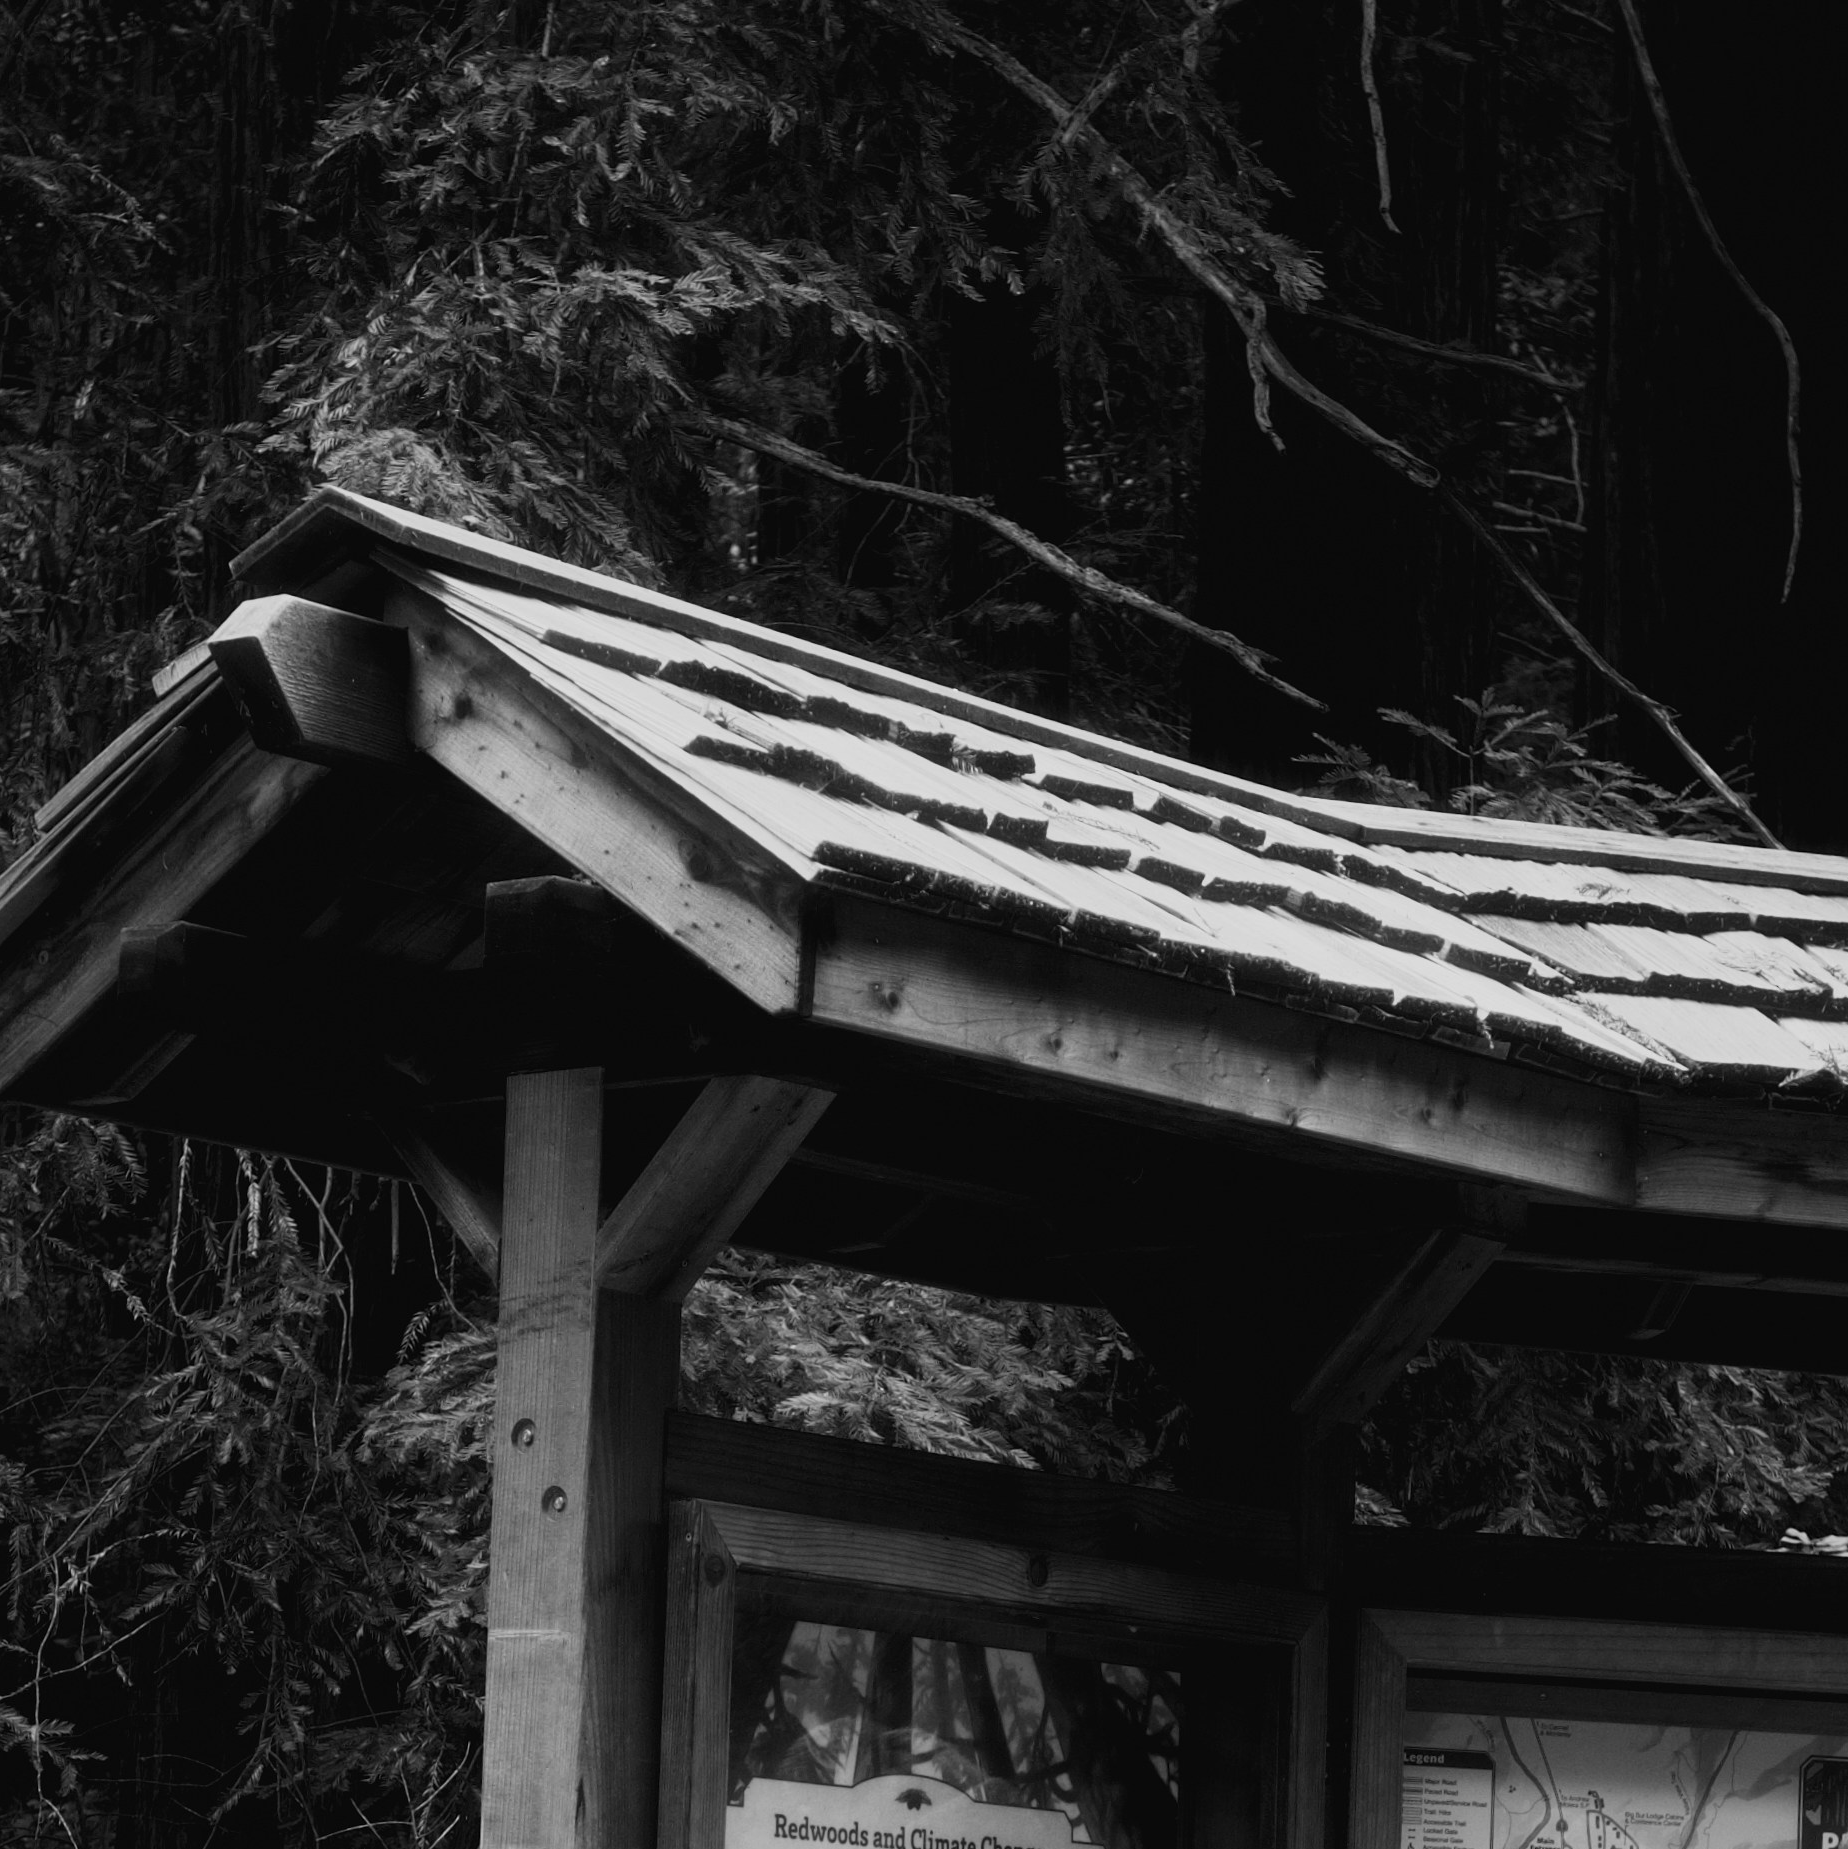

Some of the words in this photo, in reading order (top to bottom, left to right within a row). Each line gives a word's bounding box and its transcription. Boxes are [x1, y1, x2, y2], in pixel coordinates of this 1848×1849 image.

[1403, 1753, 1444, 1764] Legend
[774, 1814, 869, 1846] Redwoods
[873, 1827, 906, 1849] and
